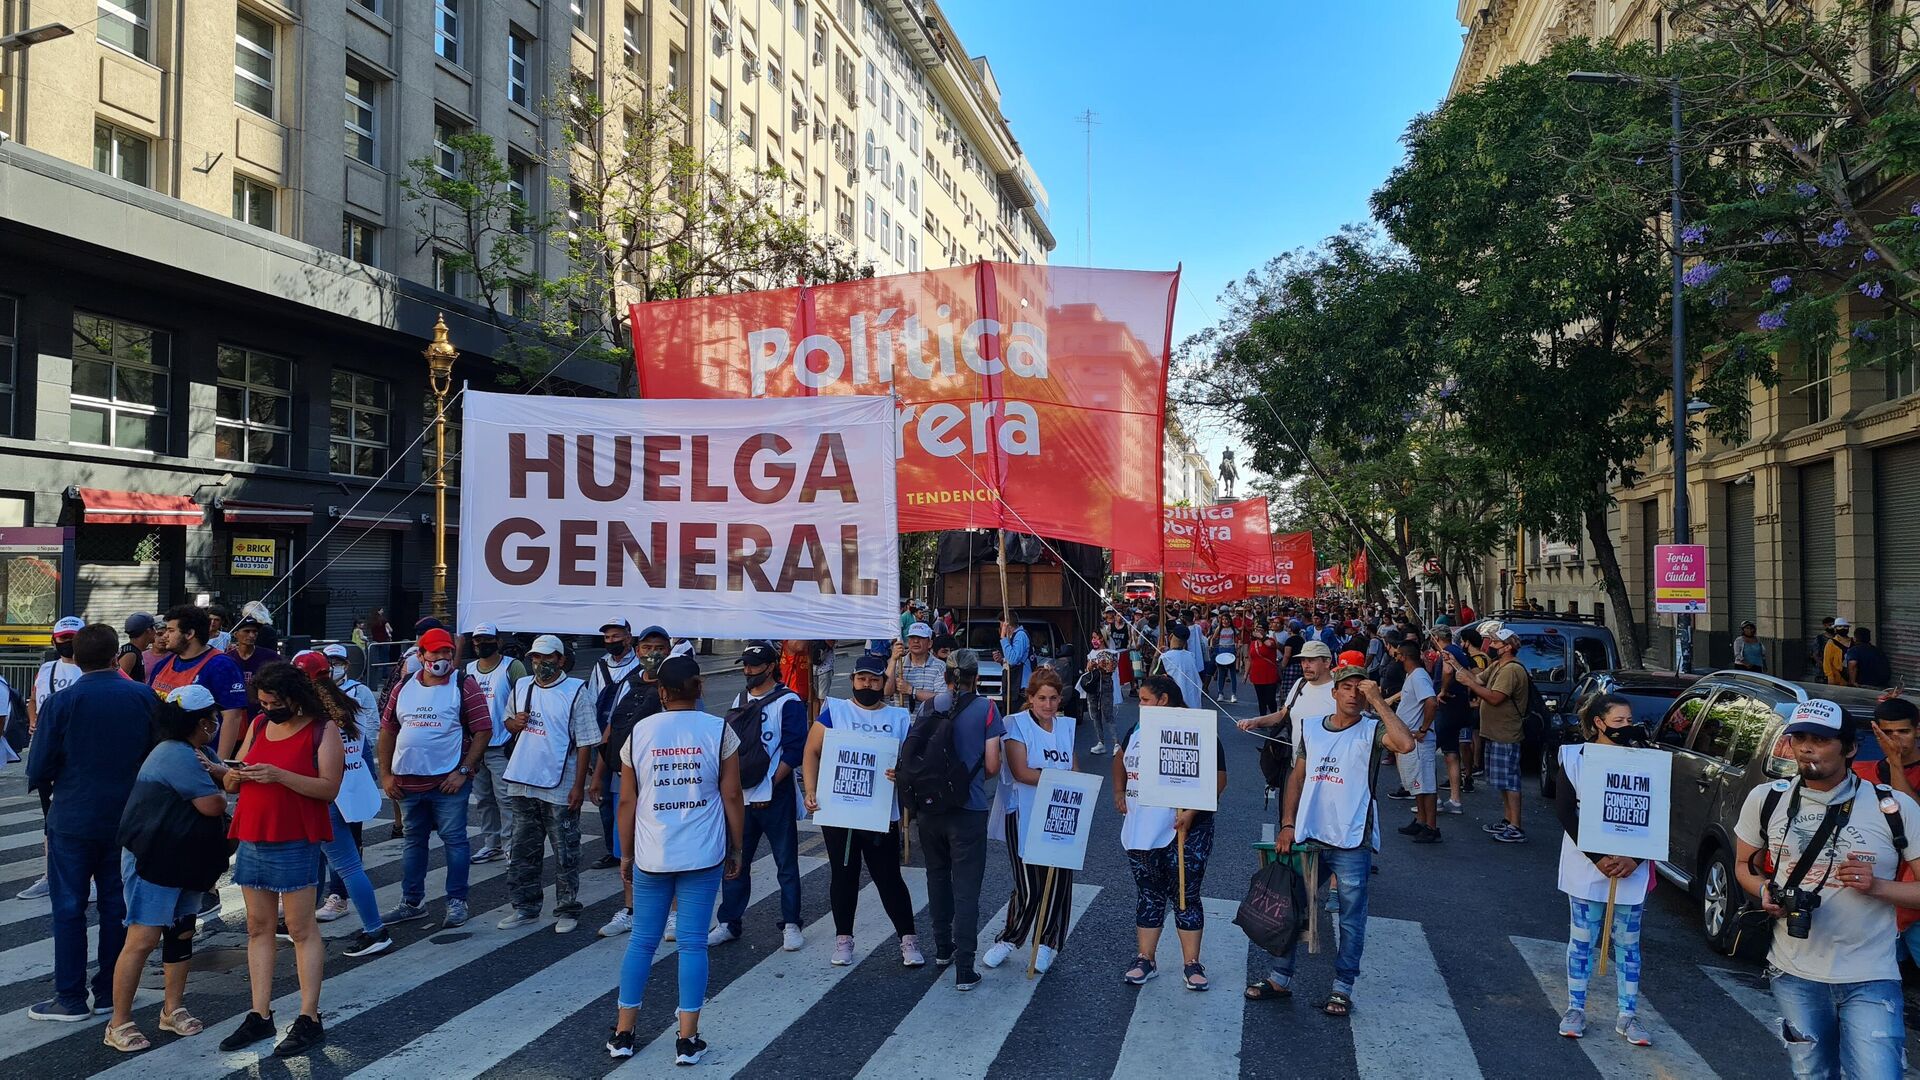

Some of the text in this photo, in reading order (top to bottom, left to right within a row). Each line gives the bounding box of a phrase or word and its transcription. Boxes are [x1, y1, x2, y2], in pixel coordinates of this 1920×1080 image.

[748, 304, 1049, 398] Política
[896, 400, 1041, 459] rera
[508, 432, 859, 504] HUELGA
[906, 488, 1001, 505] TENDENCIA
[1164, 506, 1234, 520] olítica
[246, 544, 271, 553] BRICK
[484, 516, 879, 596] GENERAL
[233, 555, 273, 563] ALQUILA
[1666, 552, 1693, 563] Ferias
[1681, 563, 1688, 571] la
[1665, 571, 1697, 582] Ciudad
[1797, 708, 1830, 718] Obrera
[1799, 700, 1835, 712] Política
[852, 721, 893, 733] POLO
[1160, 730, 1199, 746] NO AL FMI
[651, 747, 703, 757] TENDENCIA
[838, 749, 876, 767] NO AL FMI
[1043, 748, 1070, 763] POLO
[1160, 748, 1198, 763] CONGRESO
[653, 760, 701, 772] PTE PERÓN
[1161, 760, 1197, 776] OBRERO
[653, 776, 703, 787] LAS LOMAS
[839, 767, 870, 783] HUELGA
[1606, 772, 1650, 792] NO AL FMI
[834, 779, 871, 796] GENERAL
[653, 799, 708, 811] SEGURIDAD
[1051, 788, 1084, 806] NO AL FMI
[1605, 793, 1649, 811] CONGRESO
[1050, 806, 1075, 822] HUELGA
[1605, 806, 1647, 824] OBRERO
[1045, 818, 1075, 834] GENERAL
[1793, 813, 1824, 825] ANGE
[1846, 825, 1867, 845] CITY
